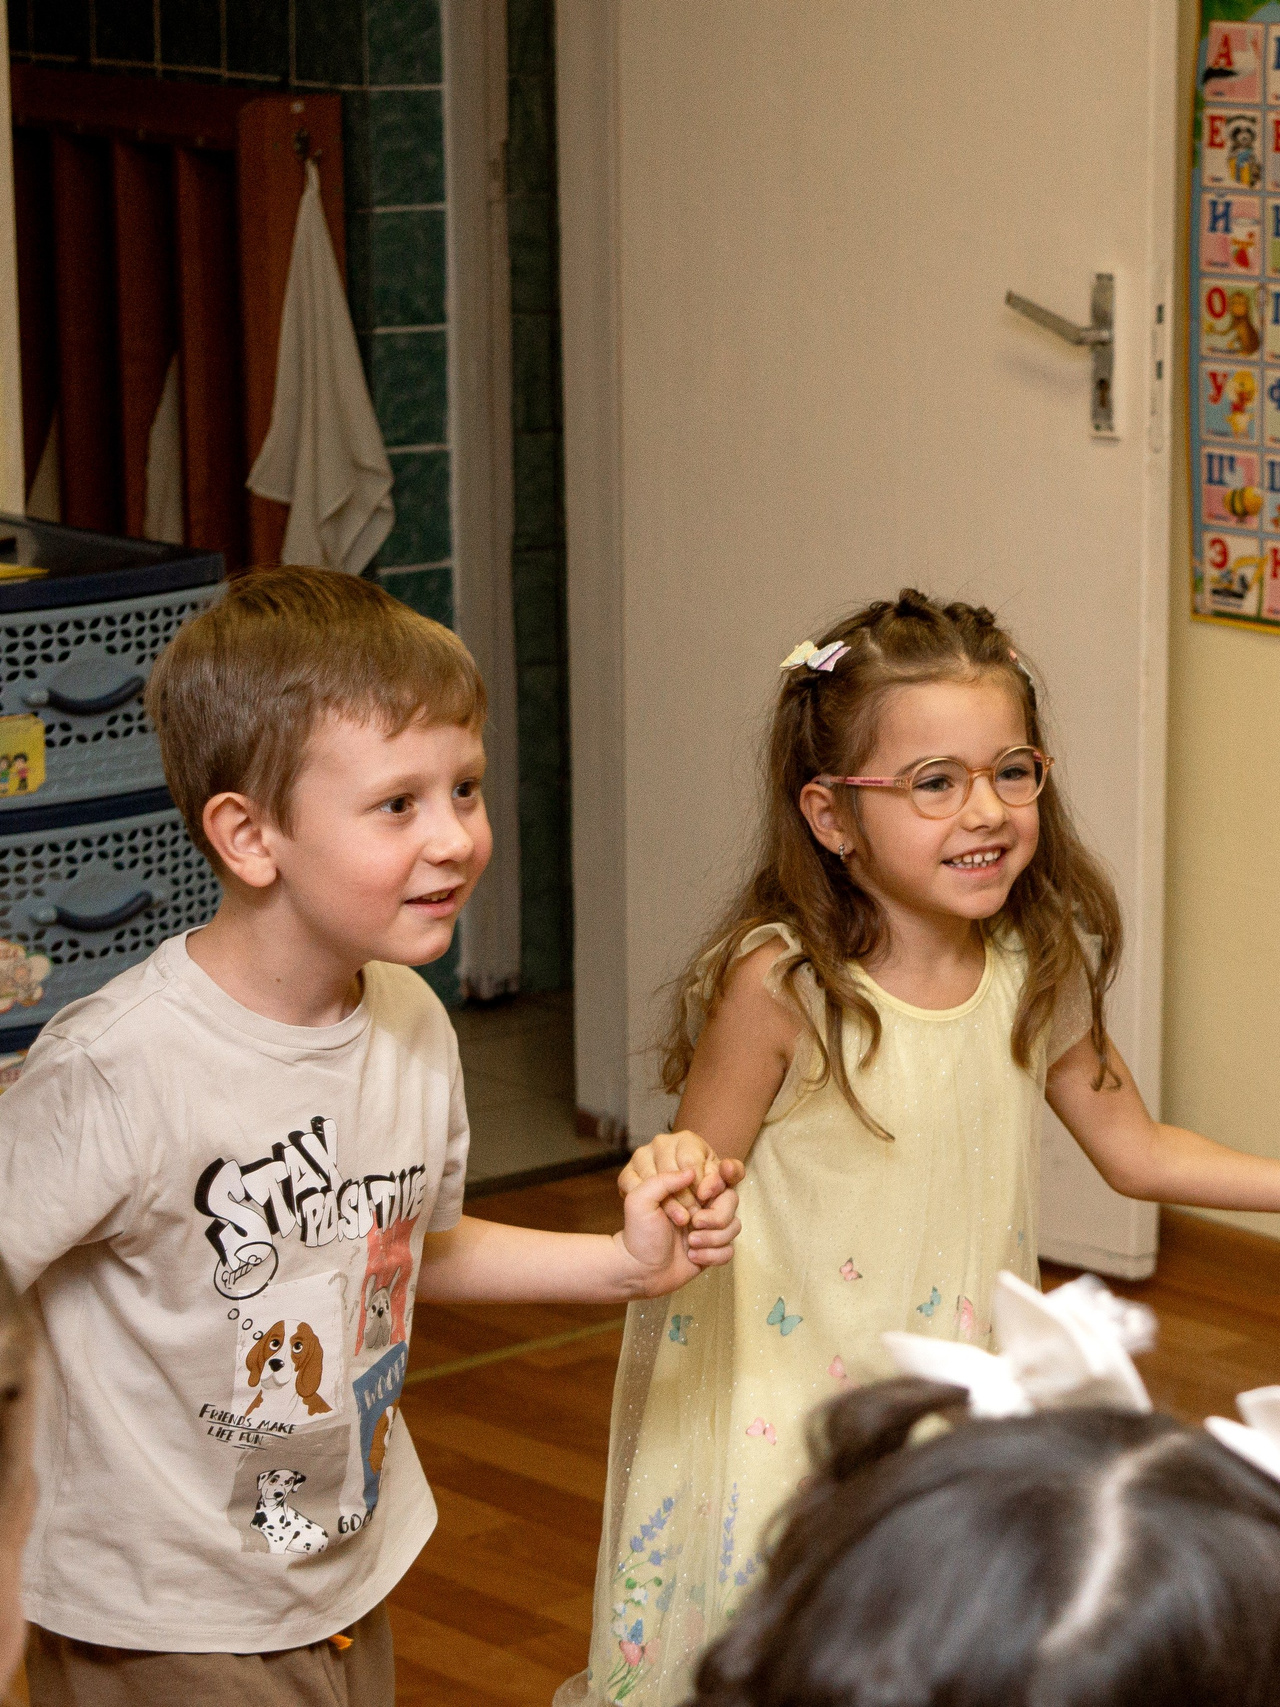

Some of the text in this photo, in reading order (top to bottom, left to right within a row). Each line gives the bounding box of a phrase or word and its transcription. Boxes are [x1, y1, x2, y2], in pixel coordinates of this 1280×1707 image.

[1212, 34, 1233, 67] А
[1208, 115, 1226, 148] Е
[1206, 287, 1227, 319] О
[1208, 372, 1228, 405] У
[1209, 538, 1228, 569] Э
[194, 1116, 343, 1271] STAY
[296, 1164, 426, 1247] POSITIVE
[199, 1403, 296, 1434] FRIENDS MAKE
[207, 1426, 263, 1445] LIFE FUN
